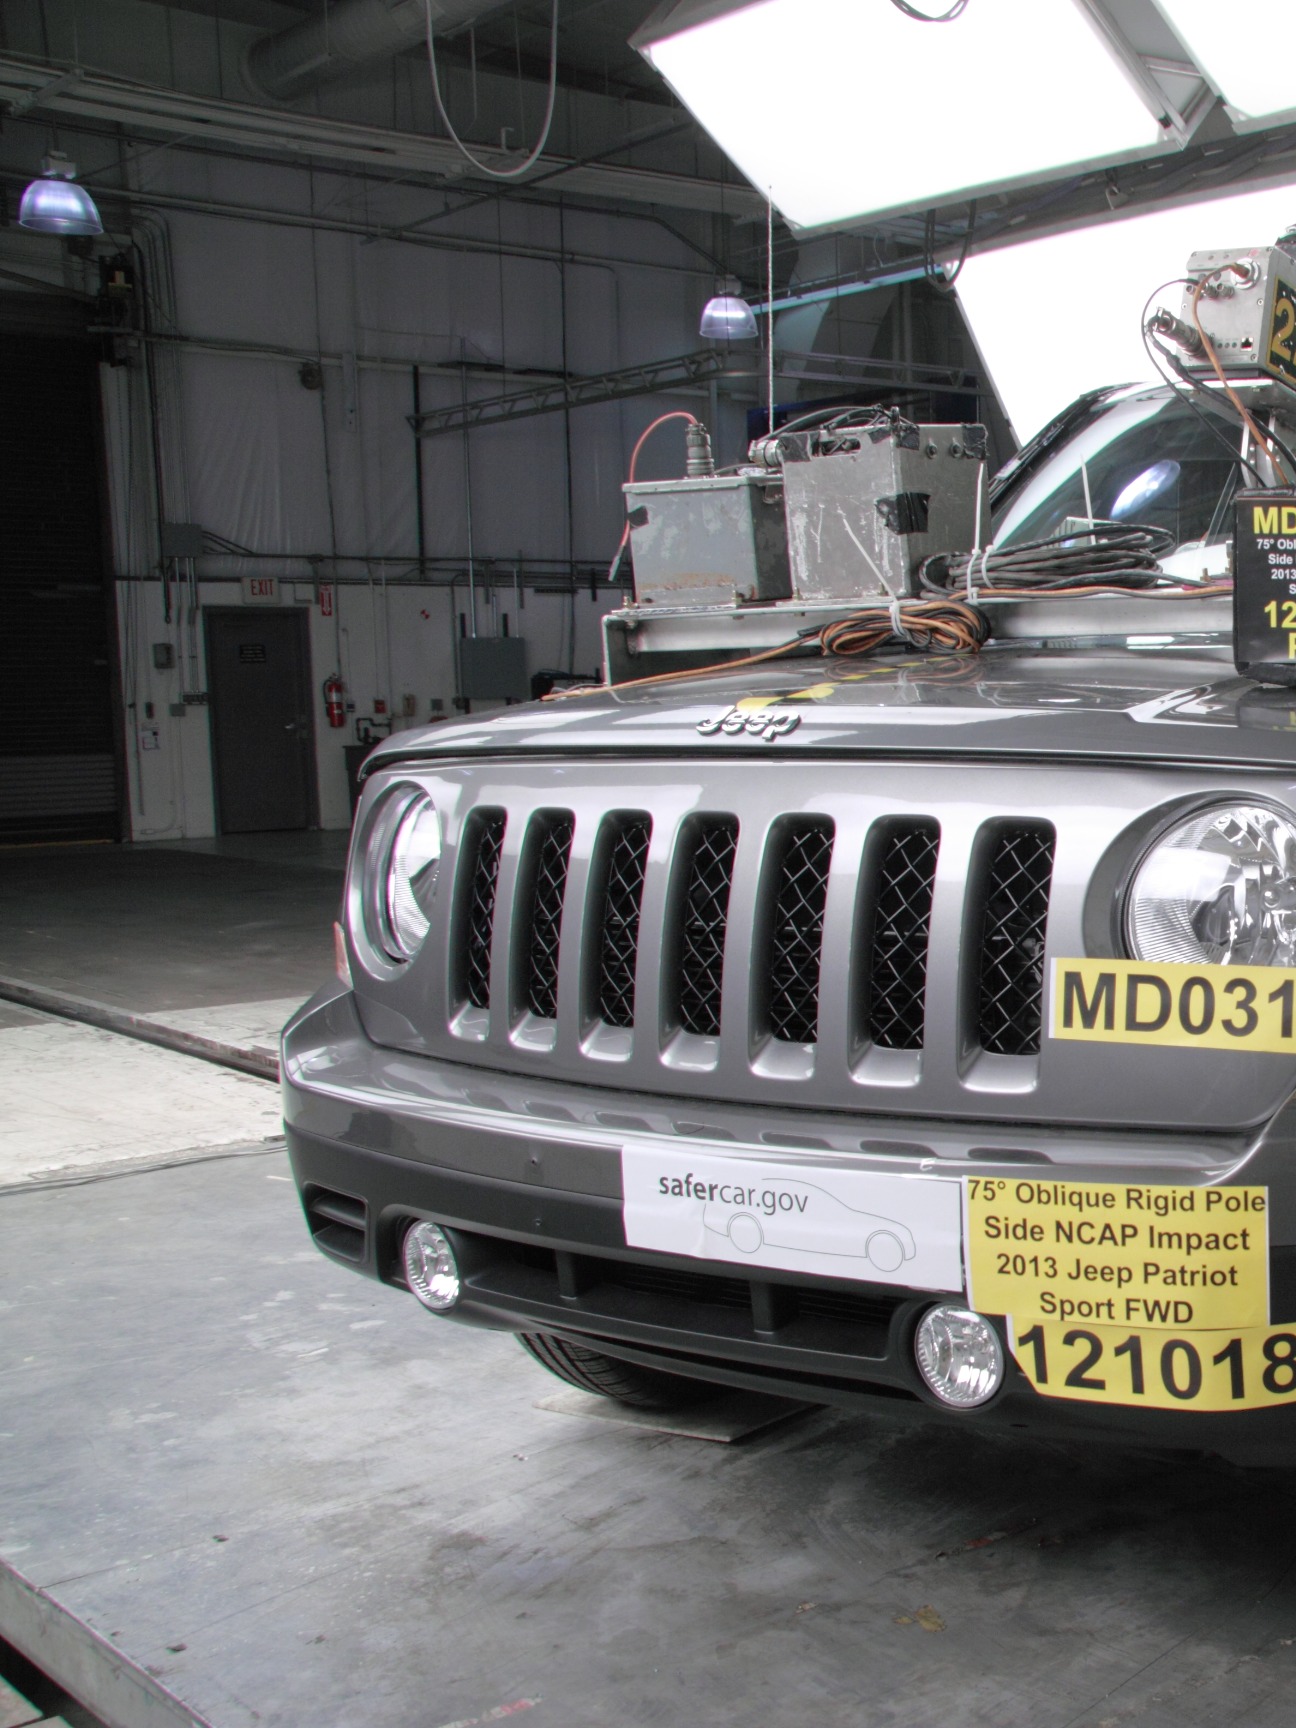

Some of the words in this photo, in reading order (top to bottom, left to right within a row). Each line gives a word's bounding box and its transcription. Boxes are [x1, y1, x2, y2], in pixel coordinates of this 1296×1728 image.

[1256, 538, 1274, 550] 75°
[1268, 553, 1293, 565] Side
[250, 578, 274, 596] EXIT
[1271, 569, 1296, 580] 2013
[696, 705, 801, 742] Jeep
[659, 1173, 808, 1216] safercar.gov
[968, 1180, 1006, 1201] 75°
[1015, 1182, 1116, 1212] Oblique
[1126, 1188, 1195, 1216] Rigid
[1206, 1190, 1266, 1212] Pole
[984, 1216, 1045, 1241] Side
[1055, 1220, 1138, 1247] NCAP
[1149, 1225, 1250, 1256] Impact
[997, 1253, 1058, 1279] 2013
[1067, 1258, 1133, 1288] Jeep
[1143, 1262, 1238, 1286] Patriot
[1040, 1291, 1115, 1321] Sport
[1125, 1298, 1194, 1324] FWD
